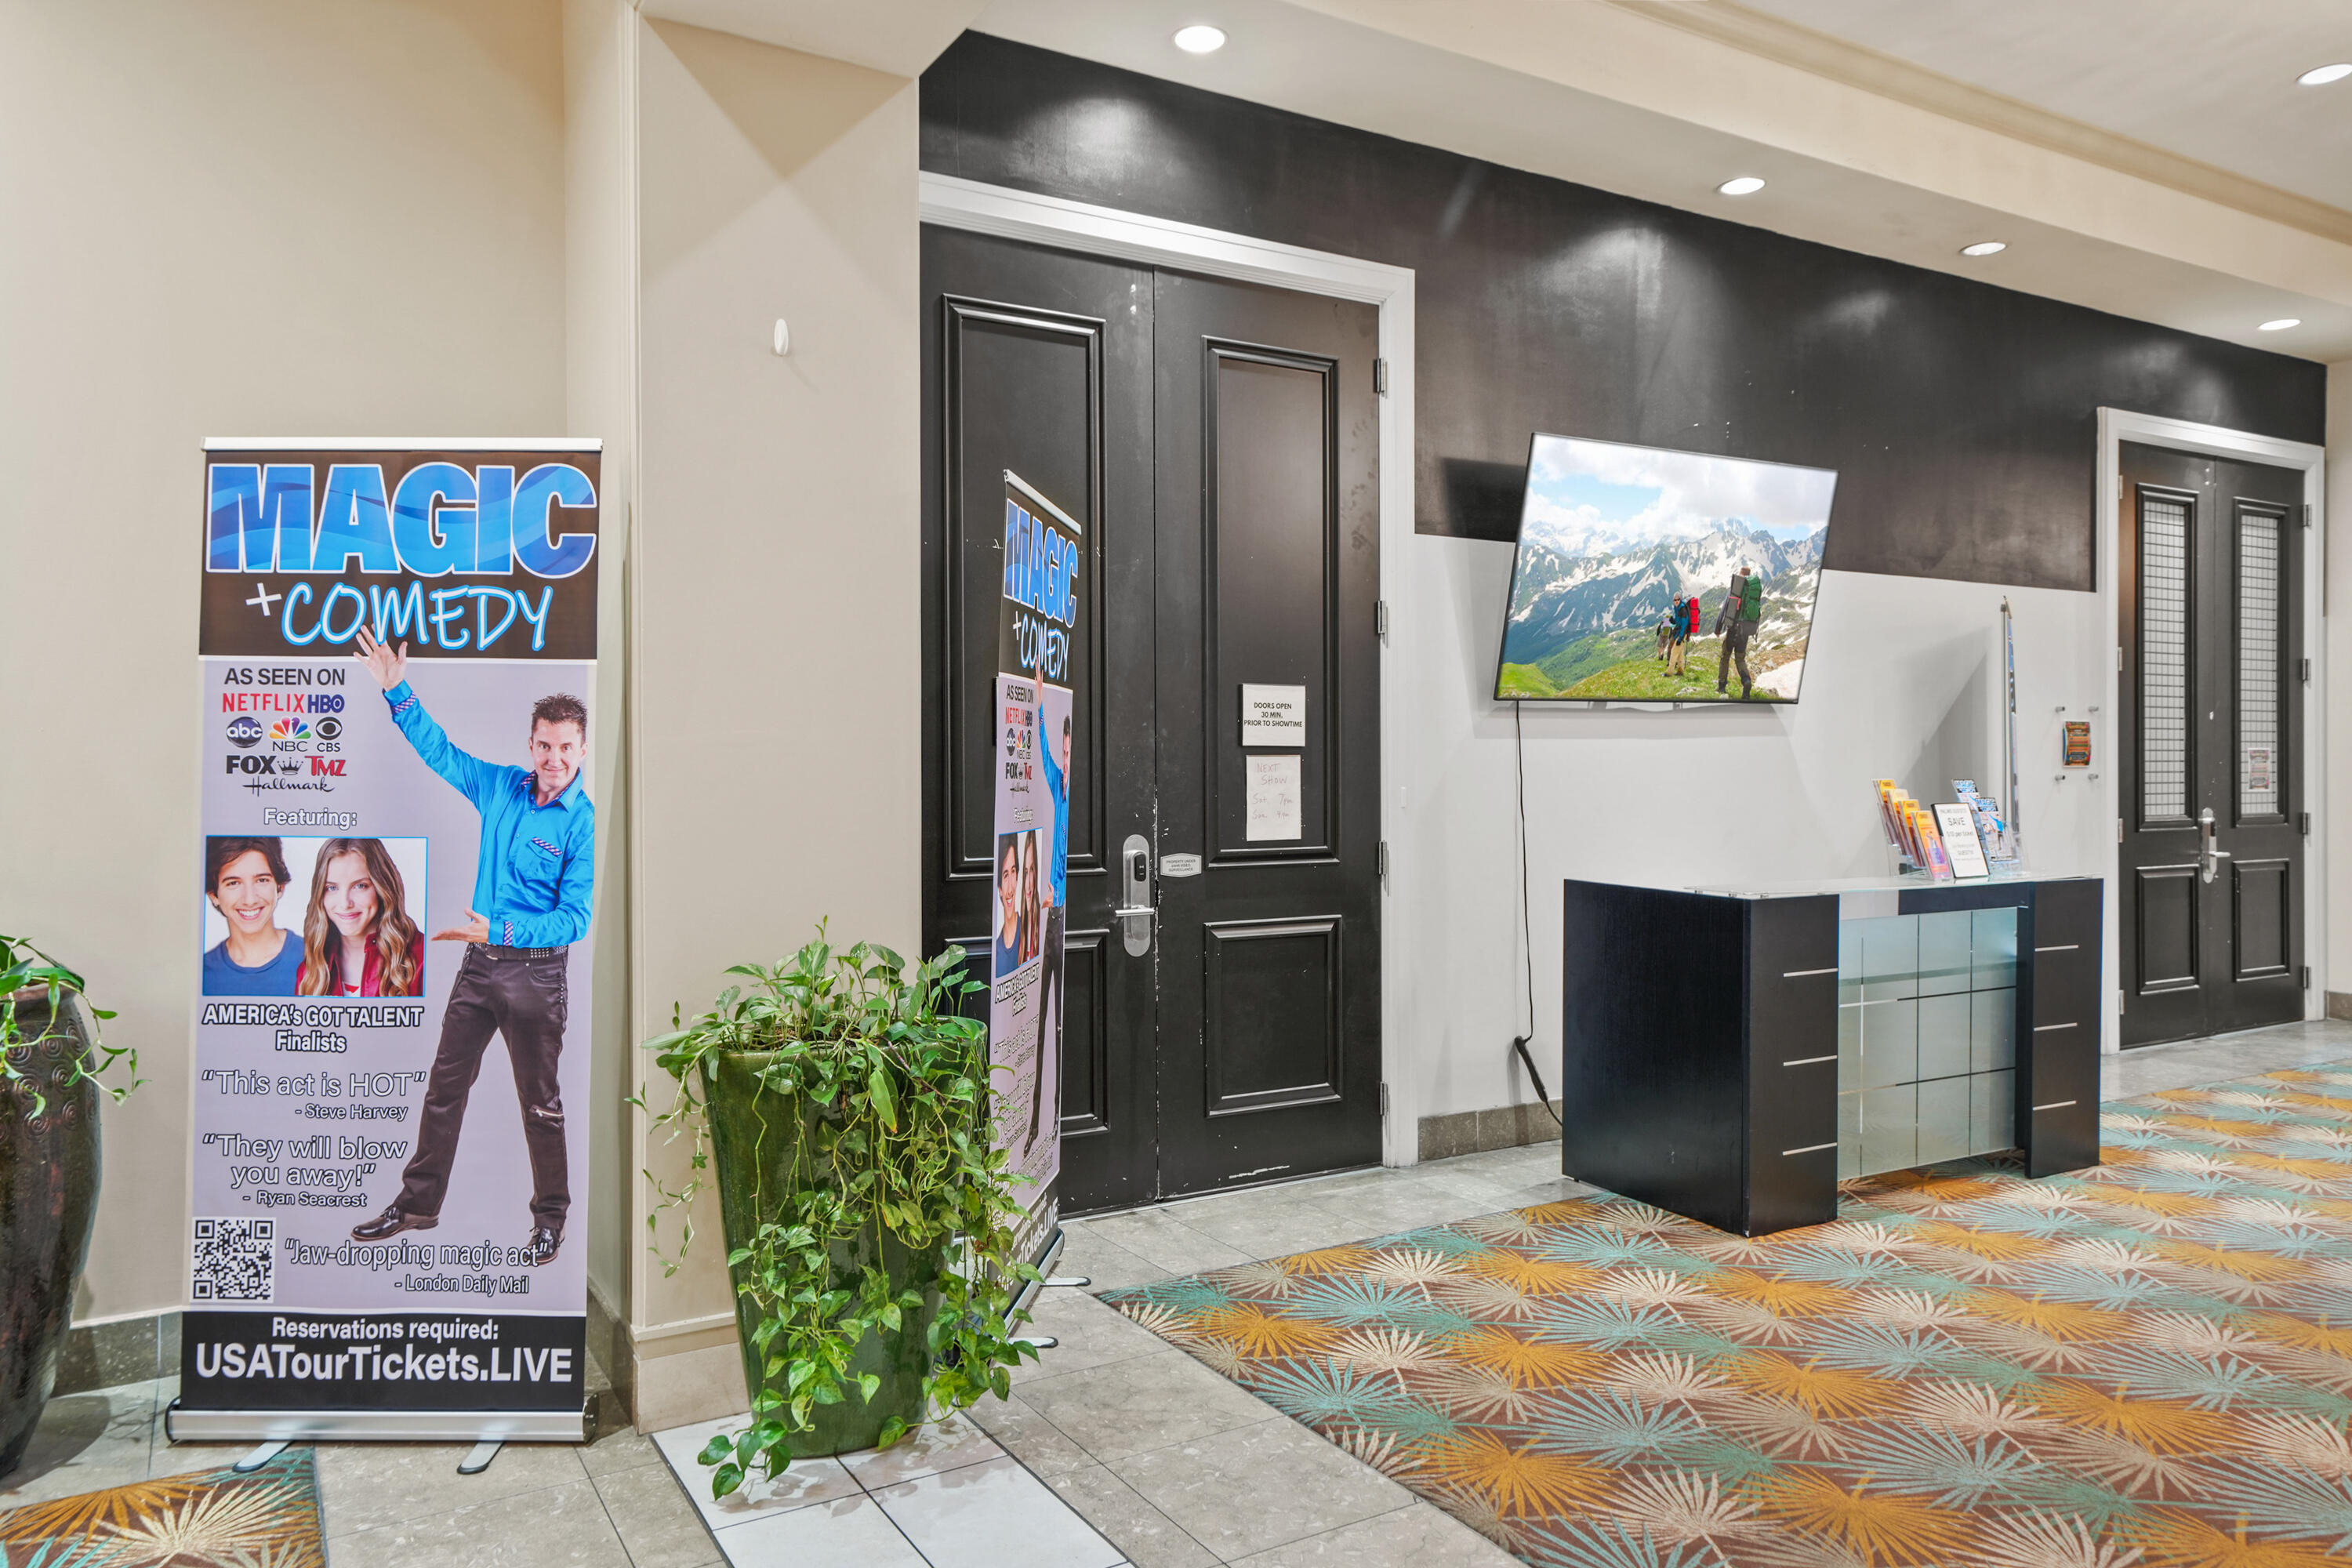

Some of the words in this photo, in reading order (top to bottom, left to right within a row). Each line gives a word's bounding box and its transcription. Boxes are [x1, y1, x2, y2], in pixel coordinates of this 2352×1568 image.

[206, 462, 597, 579] MAGIC
[1004, 498, 1078, 628] MAGIC
[224, 668, 253, 685] AS
[258, 668, 311, 685] SEEN
[317, 669, 345, 685] ON
[223, 693, 305, 713] NETFLIX
[307, 694, 345, 713] HBO
[1007, 684, 1014, 700] AS
[1014, 686, 1027, 702] SEEN
[1027, 688, 1033, 703] ON
[1005, 707, 1025, 726] NETFLIX
[227, 723, 263, 739] abc
[272, 741, 308, 752] NBC
[317, 742, 340, 753] CBS
[226, 755, 277, 775] FOX
[304, 756, 347, 776] TMZ
[1006, 762, 1018, 779] FOX
[1257, 763, 1280, 772] NEXT
[242, 775, 335, 797] Hallmark
[1261, 774, 1287, 785] SHOW
[264, 808, 357, 831] Featuring:
[1947, 817, 1966, 826] SAVE
[305, 1005, 344, 1027] GOT
[346, 1006, 424, 1027] TALENT
[275, 1029, 347, 1052] Finalists
[277, 1073, 314, 1096] act
[321, 1072, 341, 1097] is
[305, 1103, 346, 1119] Steve
[350, 1105, 408, 1122] Harvey
[289, 1135, 331, 1159] will
[339, 1136, 408, 1160] blow
[231, 1166, 279, 1189] you
[256, 1190, 295, 1207] Ryan
[298, 1192, 367, 1207] Seacrest
[440, 1240, 502, 1270] magic
[405, 1273, 459, 1293] London
[462, 1275, 497, 1297] Daily
[499, 1276, 529, 1294] Mail
[271, 1316, 404, 1340] Reservations
[408, 1318, 499, 1344] required:
[196, 1342, 572, 1383] USATourTickets.LIVE
